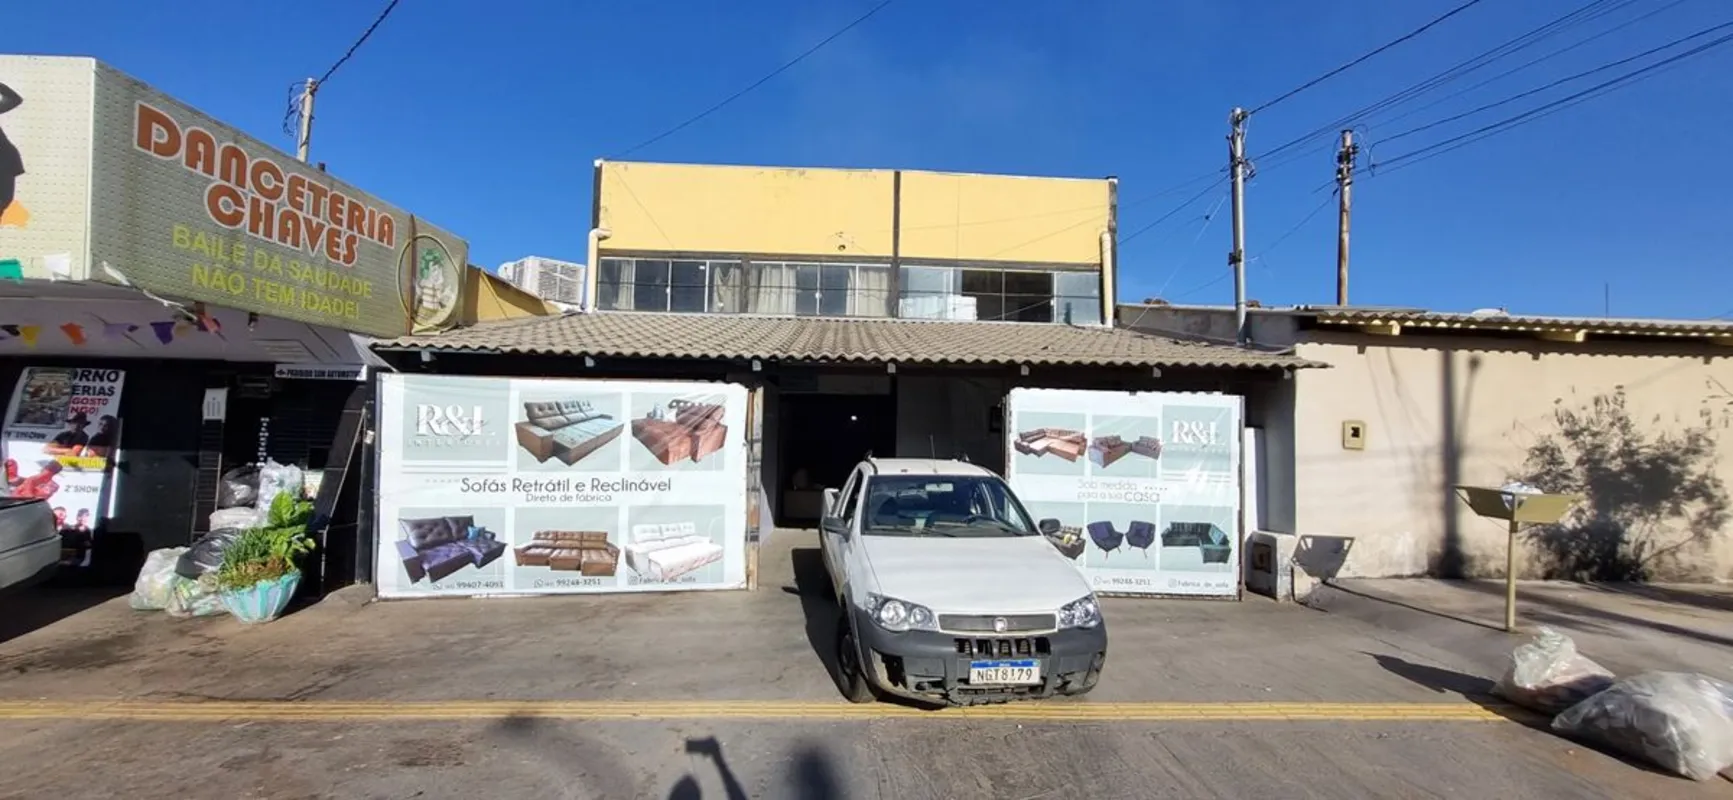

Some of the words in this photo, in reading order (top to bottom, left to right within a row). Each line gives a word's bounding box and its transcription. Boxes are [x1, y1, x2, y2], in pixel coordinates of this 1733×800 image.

[134, 101, 396, 249] DANCETERIA
[204, 182, 360, 267] CHAVES
[192, 262, 245, 295] NÃO
[252, 277, 295, 306] TEM
[253, 248, 282, 276] DA
[289, 259, 373, 299] SAUDADE
[460, 477, 507, 493] Sofás
[512, 477, 570, 493] Retrátil
[575, 481, 586, 492] e
[591, 477, 672, 492] Reclinável
[526, 493, 557, 503] Direto
[559, 493, 573, 502] de
[1124, 491, 1160, 503] casa
